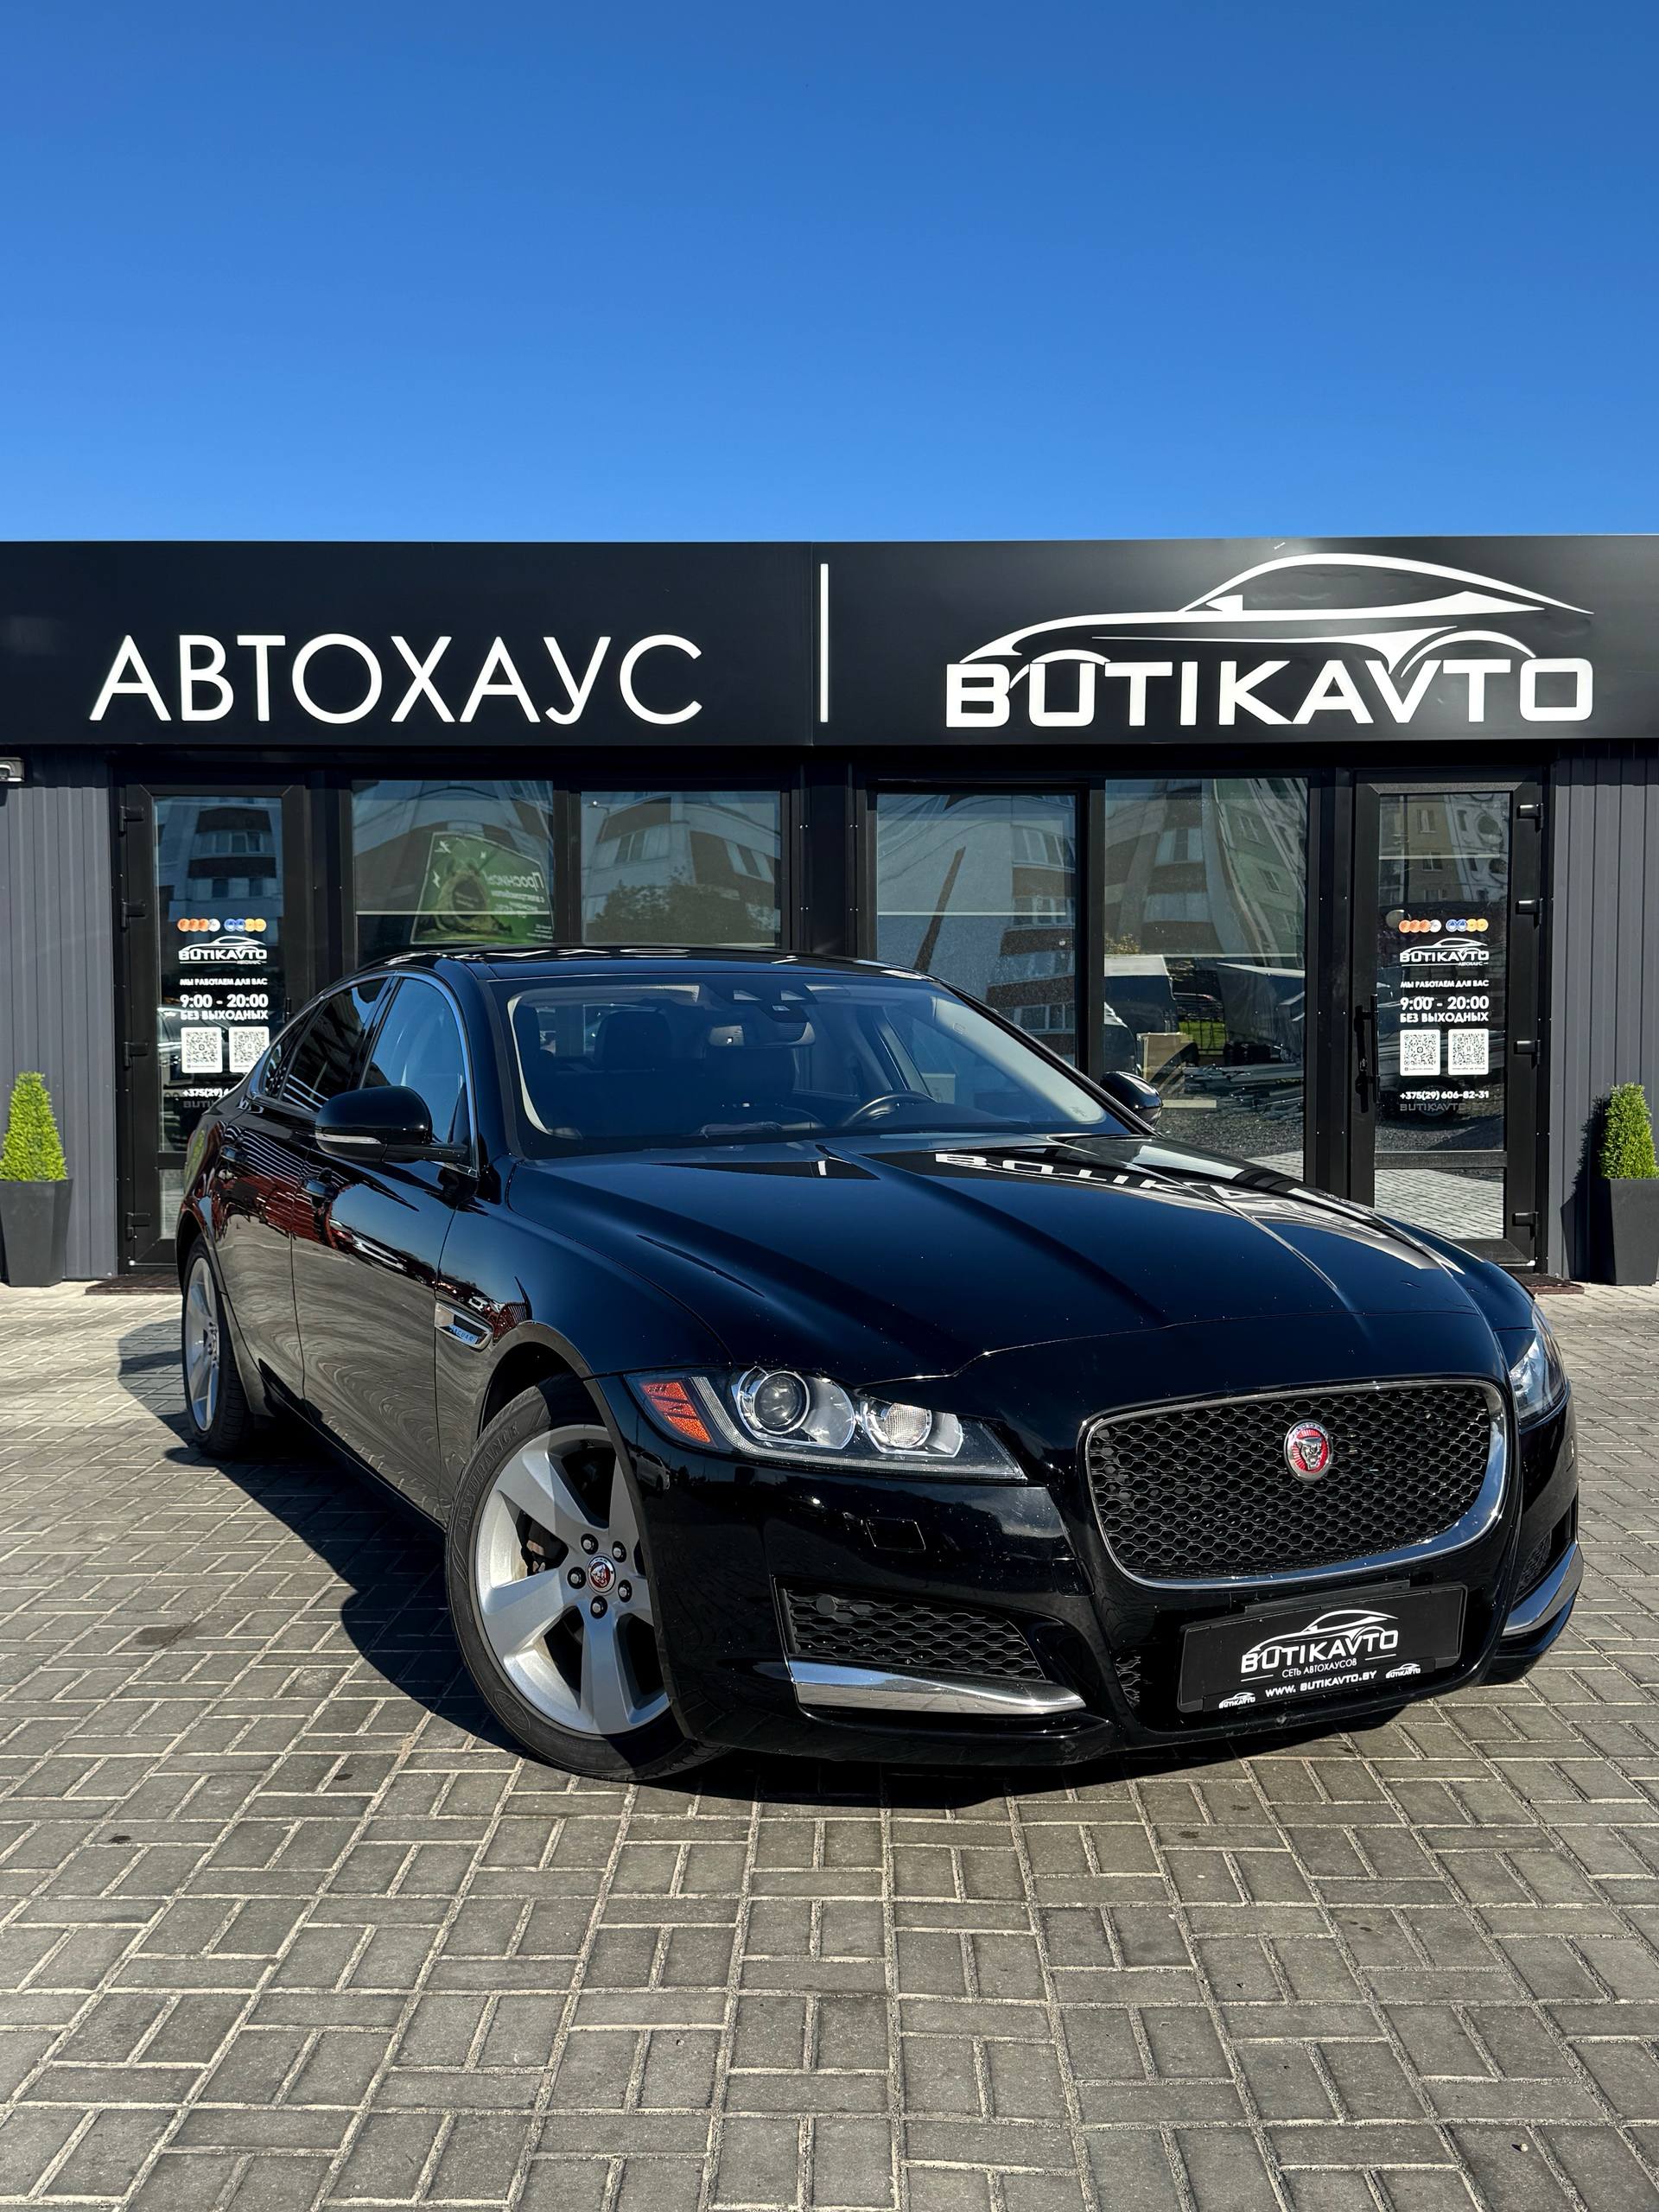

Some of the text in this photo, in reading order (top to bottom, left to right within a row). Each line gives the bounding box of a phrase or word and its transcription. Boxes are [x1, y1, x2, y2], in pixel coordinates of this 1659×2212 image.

[89, 633, 702, 726] АВТОХАУС
[946, 657, 1594, 728] BUTIKAVTO
[178, 949, 267, 961] BUTIKAVTO
[1400, 950, 1490, 963] BUTIKAVTO
[180, 994, 213, 1008] 9:00
[226, 994, 269, 1008] 20:00
[1400, 996, 1433, 1010] 9:00
[1447, 995, 1490, 1009] 20:00
[180, 1010, 269, 1020] БЕЗ ВЫХОДНЫХ
[1400, 1012, 1489, 1023] БЕЗ ВЫХОДНЫХ
[1400, 1090, 1490, 1100] +375(29) 606-82-31
[1241, 1630, 1399, 1674] BUTIKAVTO
[1281, 1657, 1357, 1678] СЕТЬ АВТОХАУСОВ
[1265, 1669, 1377, 1698] WWW. BUTIKAVTO.BY
